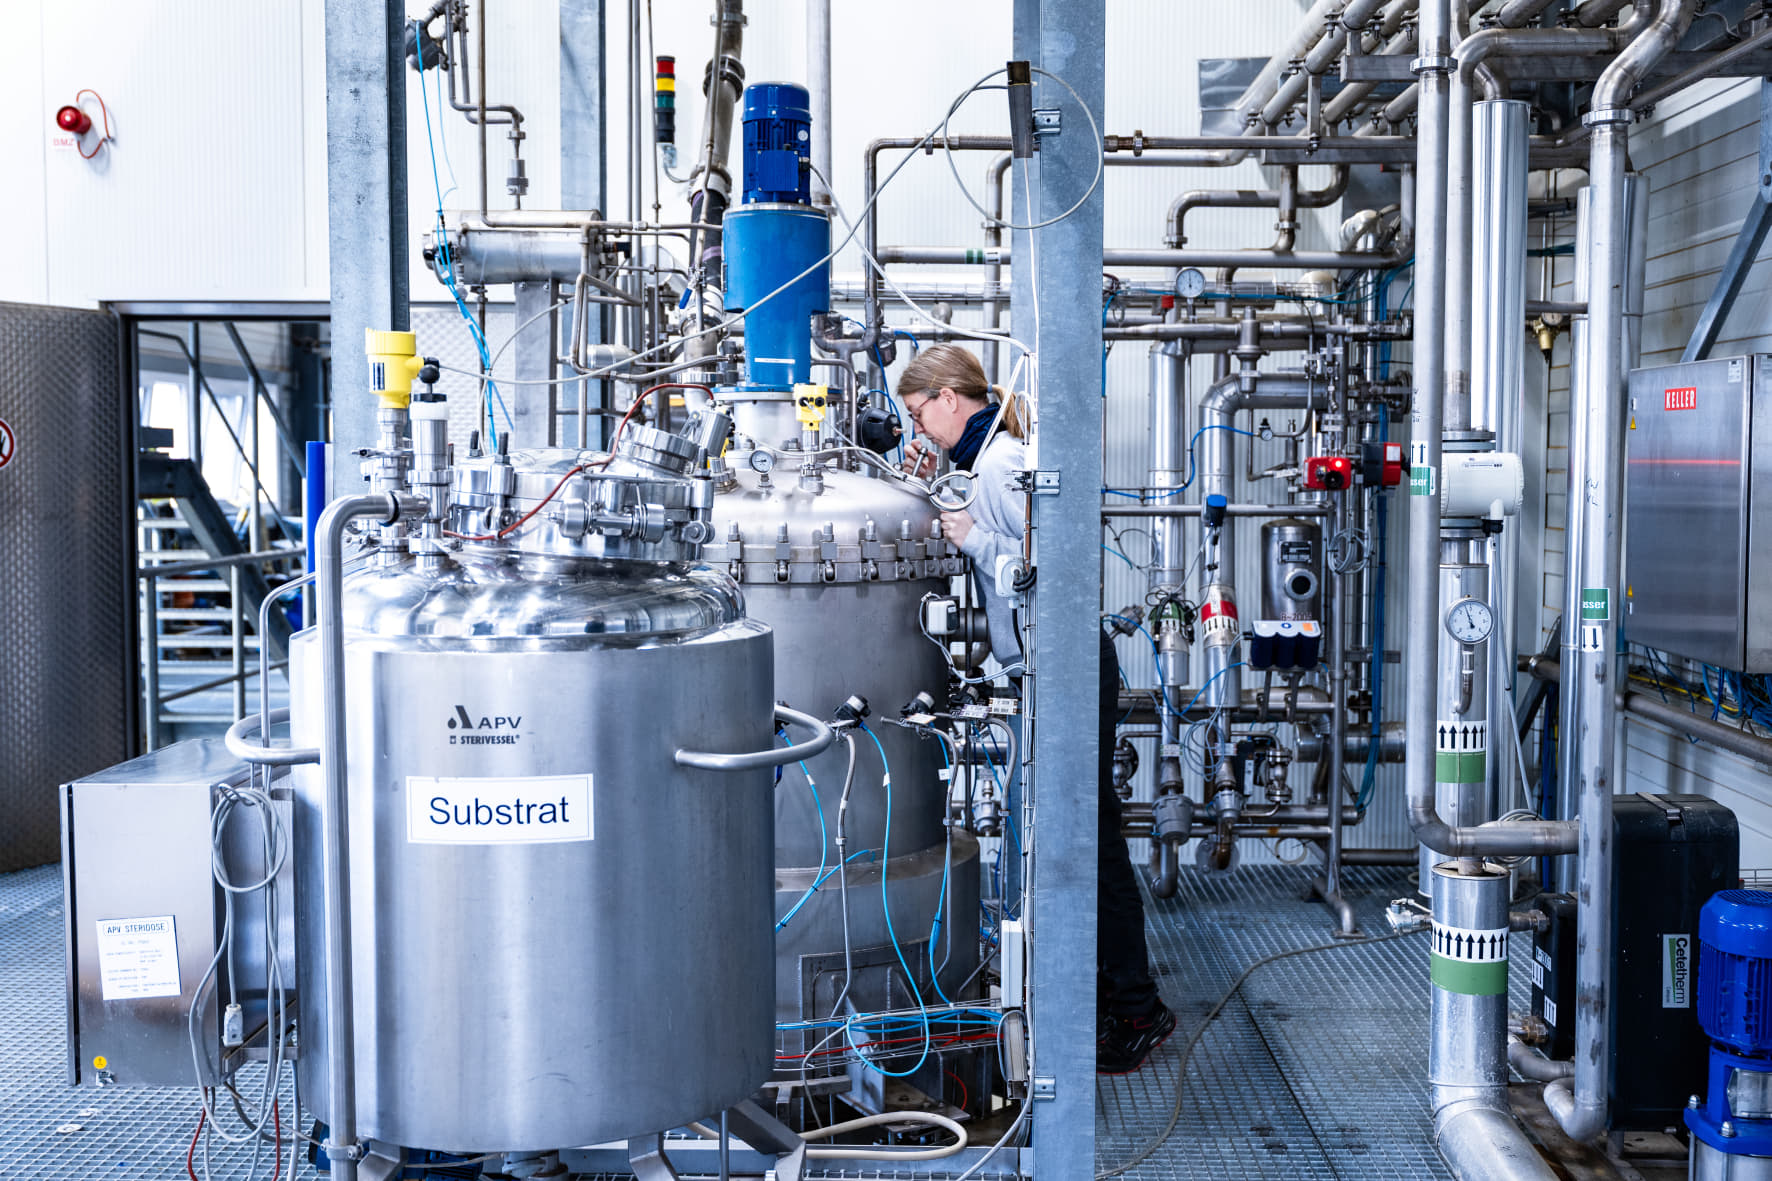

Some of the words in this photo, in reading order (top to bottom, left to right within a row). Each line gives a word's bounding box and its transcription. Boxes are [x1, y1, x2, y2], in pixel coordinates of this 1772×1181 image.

[1665, 390, 1695, 409] KELLER
[477, 716, 522, 729] APV
[429, 796, 570, 826] Substrat
[107, 925, 121, 934] APV
[125, 922, 165, 933] STERIDOSE
[1675, 937, 1688, 1004] Cetetherm
